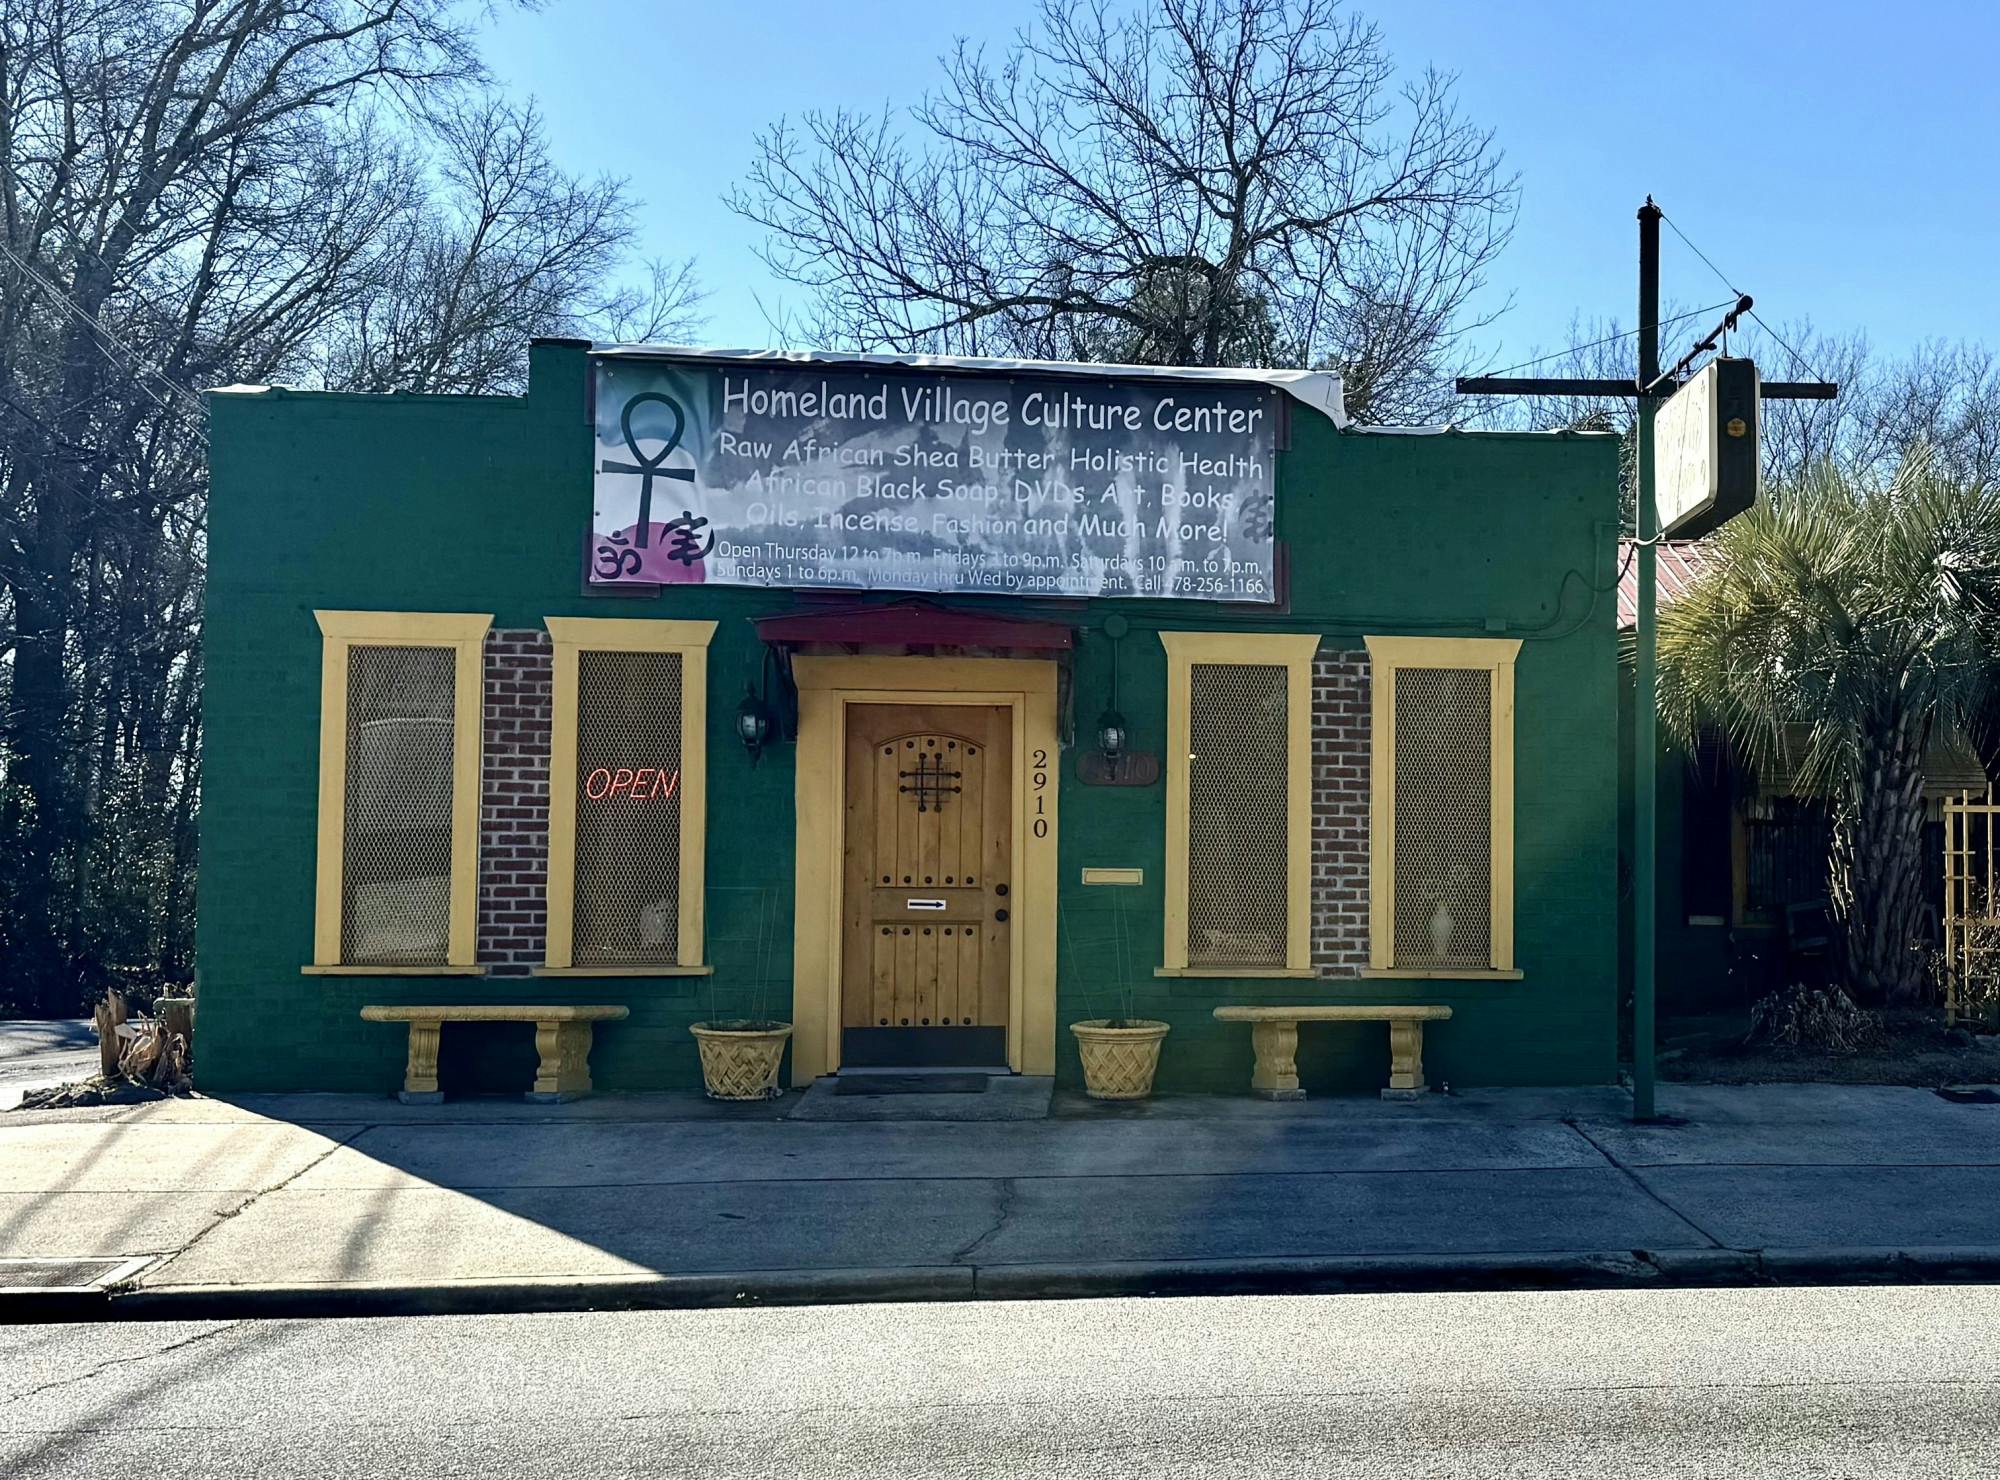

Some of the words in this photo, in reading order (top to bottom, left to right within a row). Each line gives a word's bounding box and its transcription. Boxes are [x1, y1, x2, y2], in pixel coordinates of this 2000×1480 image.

[722, 377, 888, 420] Homeland
[901, 386, 1010, 435] Village
[1021, 391, 1143, 431] Culture
[1153, 398, 1264, 434] Center
[719, 432, 772, 459] Raw
[782, 439, 884, 466] African
[893, 443, 959, 468] Shea
[1070, 447, 1169, 473] Holistic
[1179, 451, 1263, 480] Health
[745, 469, 846, 497] African
[857, 475, 926, 499] Black
[1015, 479, 1091, 506] DVDs,
[1100, 482, 1151, 508] At,
[746, 502, 805, 530] Oils,
[814, 507, 925, 535] Incense,
[932, 513, 1017, 534] Fashion
[1023, 512, 1069, 536] and
[1077, 514, 1146, 538] Much
[1156, 516, 1228, 543] More!
[717, 562, 781, 582] Sundays
[787, 564, 793, 579] 1
[799, 565, 814, 580] to
[818, 566, 861, 582] 6p.m.
[868, 567, 929, 586] Monday
[933, 568, 964, 585] thru
[968, 569, 1001, 586] Wed
[1006, 570, 1024, 590] by
[1027, 573, 1127, 591] appointent.
[1133, 574, 1161, 591] Call
[718, 541, 761, 561] Open
[765, 542, 836, 563] Thursday
[842, 546, 858, 560] 12
[863, 548, 879, 561] to
[933, 547, 986, 569] Fridays
[1003, 551, 1019, 567] to
[1023, 552, 1065, 571] 9p.m.
[1071, 552, 1144, 572] Satrdas
[1203, 558, 1218, 573] to
[587, 768, 678, 799] OPEN
[1033, 750, 1048, 838] 2910
